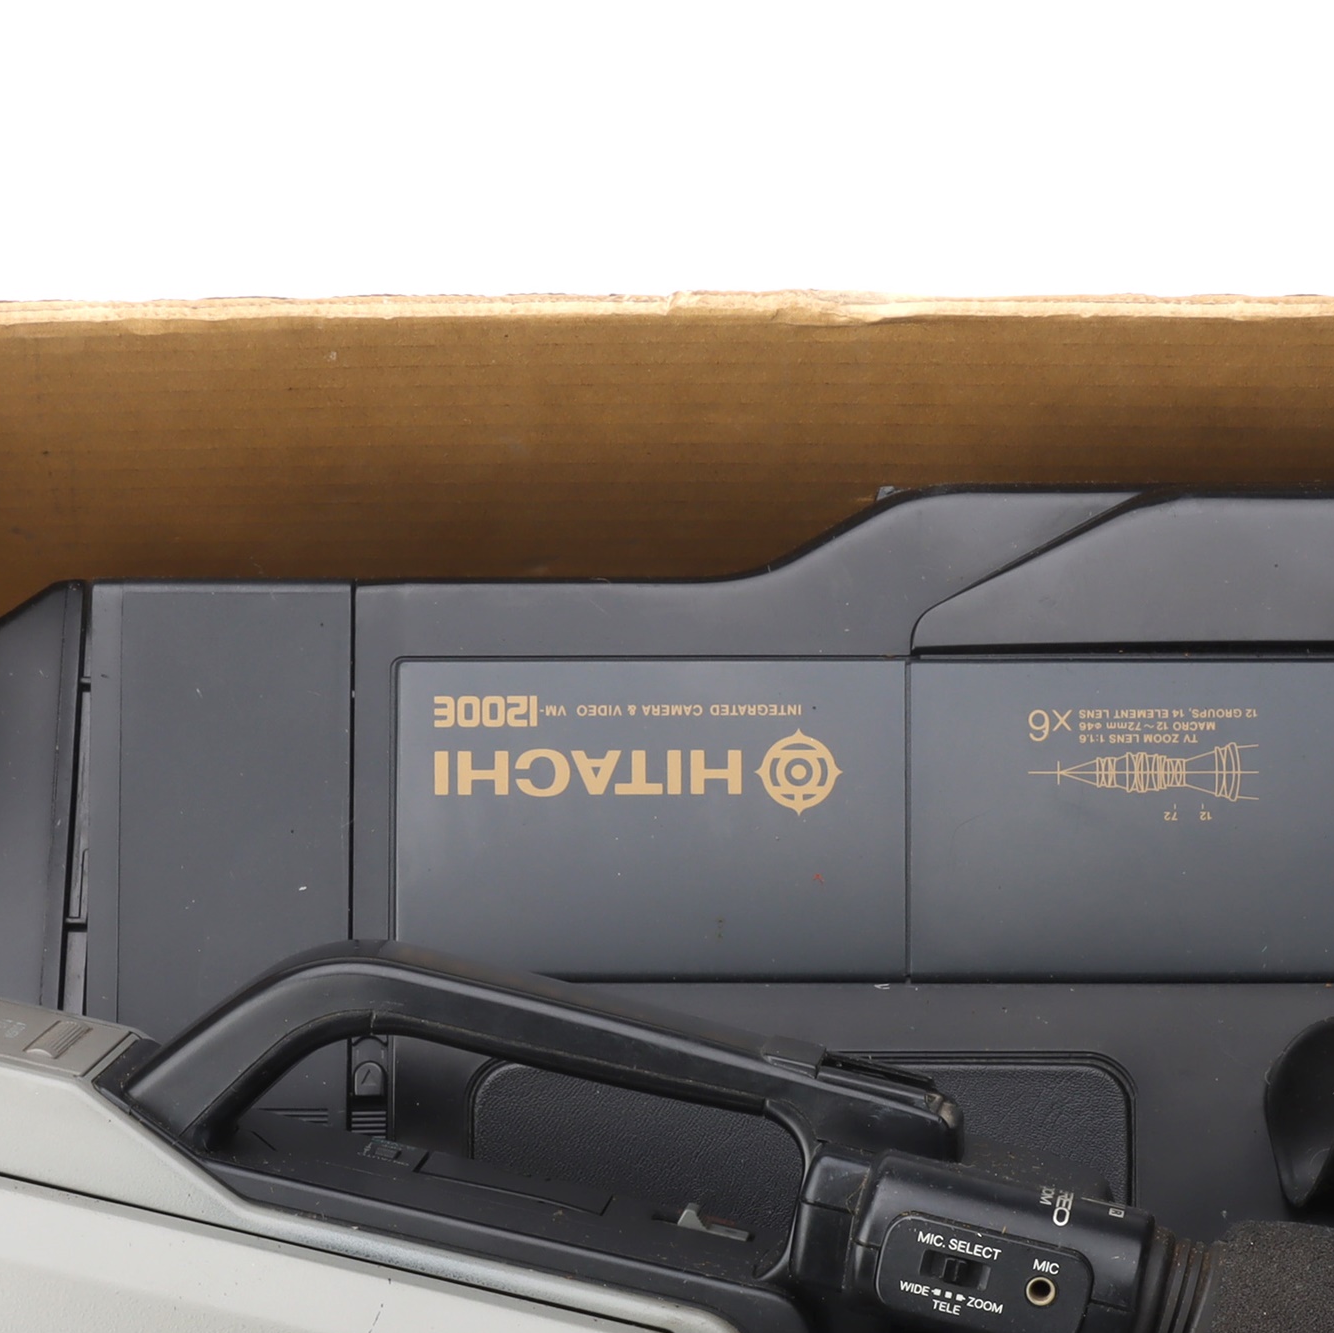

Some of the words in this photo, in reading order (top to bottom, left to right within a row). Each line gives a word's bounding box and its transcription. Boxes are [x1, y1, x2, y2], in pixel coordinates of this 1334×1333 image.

[576, 704, 623, 717] VIDEO
[627, 704, 636, 717] &
[642, 704, 704, 717] CAMERA
[709, 704, 802, 717] INTEGRATED
[1079, 708, 1110, 719] LENS
[1114, 708, 1169, 719] ELEMENT
[1172, 709, 1185, 718] 14
[1189, 708, 1243, 719] GROUPS,
[1245, 708, 1258, 718] 12
[1173, 721, 1217, 732] MACRO
[1108, 734, 1141, 744] LENS
[1143, 734, 1180, 744] ZOOM
[1183, 734, 1199, 744] TV
[433, 748, 743, 798] HITACHI
[1163, 811, 1179, 821] 72
[1199, 811, 1213, 821] 12
[917, 1230, 947, 1251] MIC.
[947, 1238, 1002, 1262] SELECT
[1032, 1258, 1060, 1276] MIC
[899, 1280, 931, 1298] WIDE
[931, 1299, 961, 1317] TELE
[966, 1296, 1004, 1315] ZOOM
